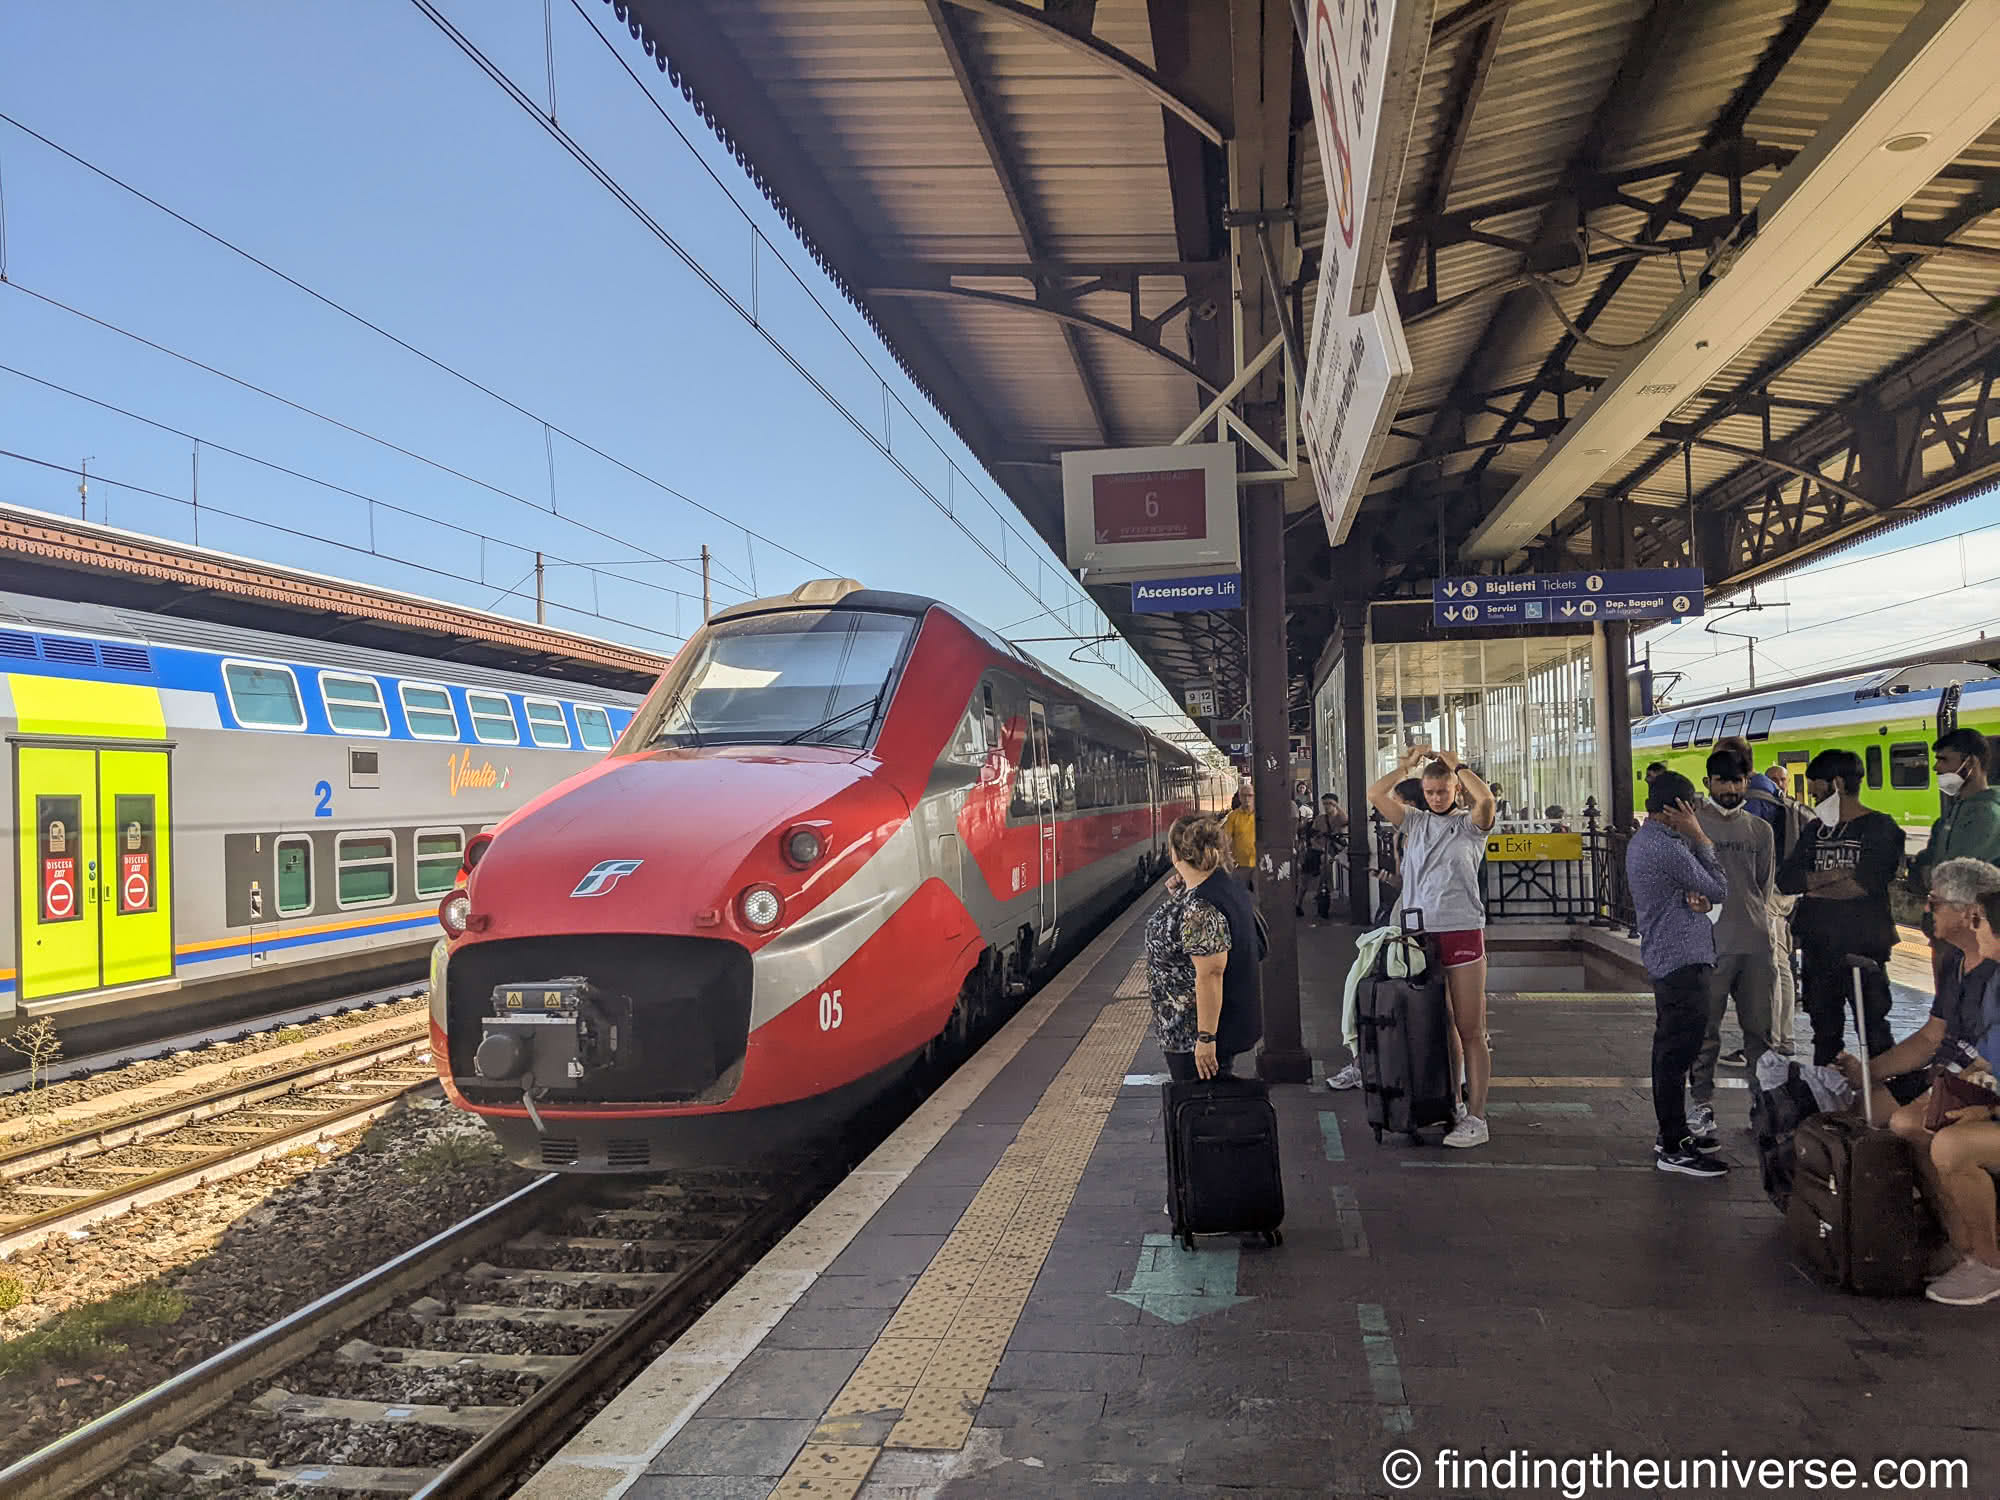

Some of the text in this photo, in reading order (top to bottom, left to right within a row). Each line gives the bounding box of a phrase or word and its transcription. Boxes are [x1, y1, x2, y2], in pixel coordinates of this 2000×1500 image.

[1145, 491, 1159, 518] 6
[1137, 581, 1236, 599] Ascensore Lift
[1485, 578, 1577, 595] Biglietti Tickets
[1487, 604, 1517, 613] Servizi
[1605, 597, 1664, 609] Dep. Bagagli
[1201, 692, 1211, 700] 12
[1202, 705, 1213, 713] 15
[448, 747, 497, 797] Vivalto
[314, 780, 332, 817] 2
[1506, 837, 1532, 853] Exit
[47, 861, 73, 870] DISCESA
[124, 856, 148, 864] DISCESA
[819, 989, 843, 1032] 05
